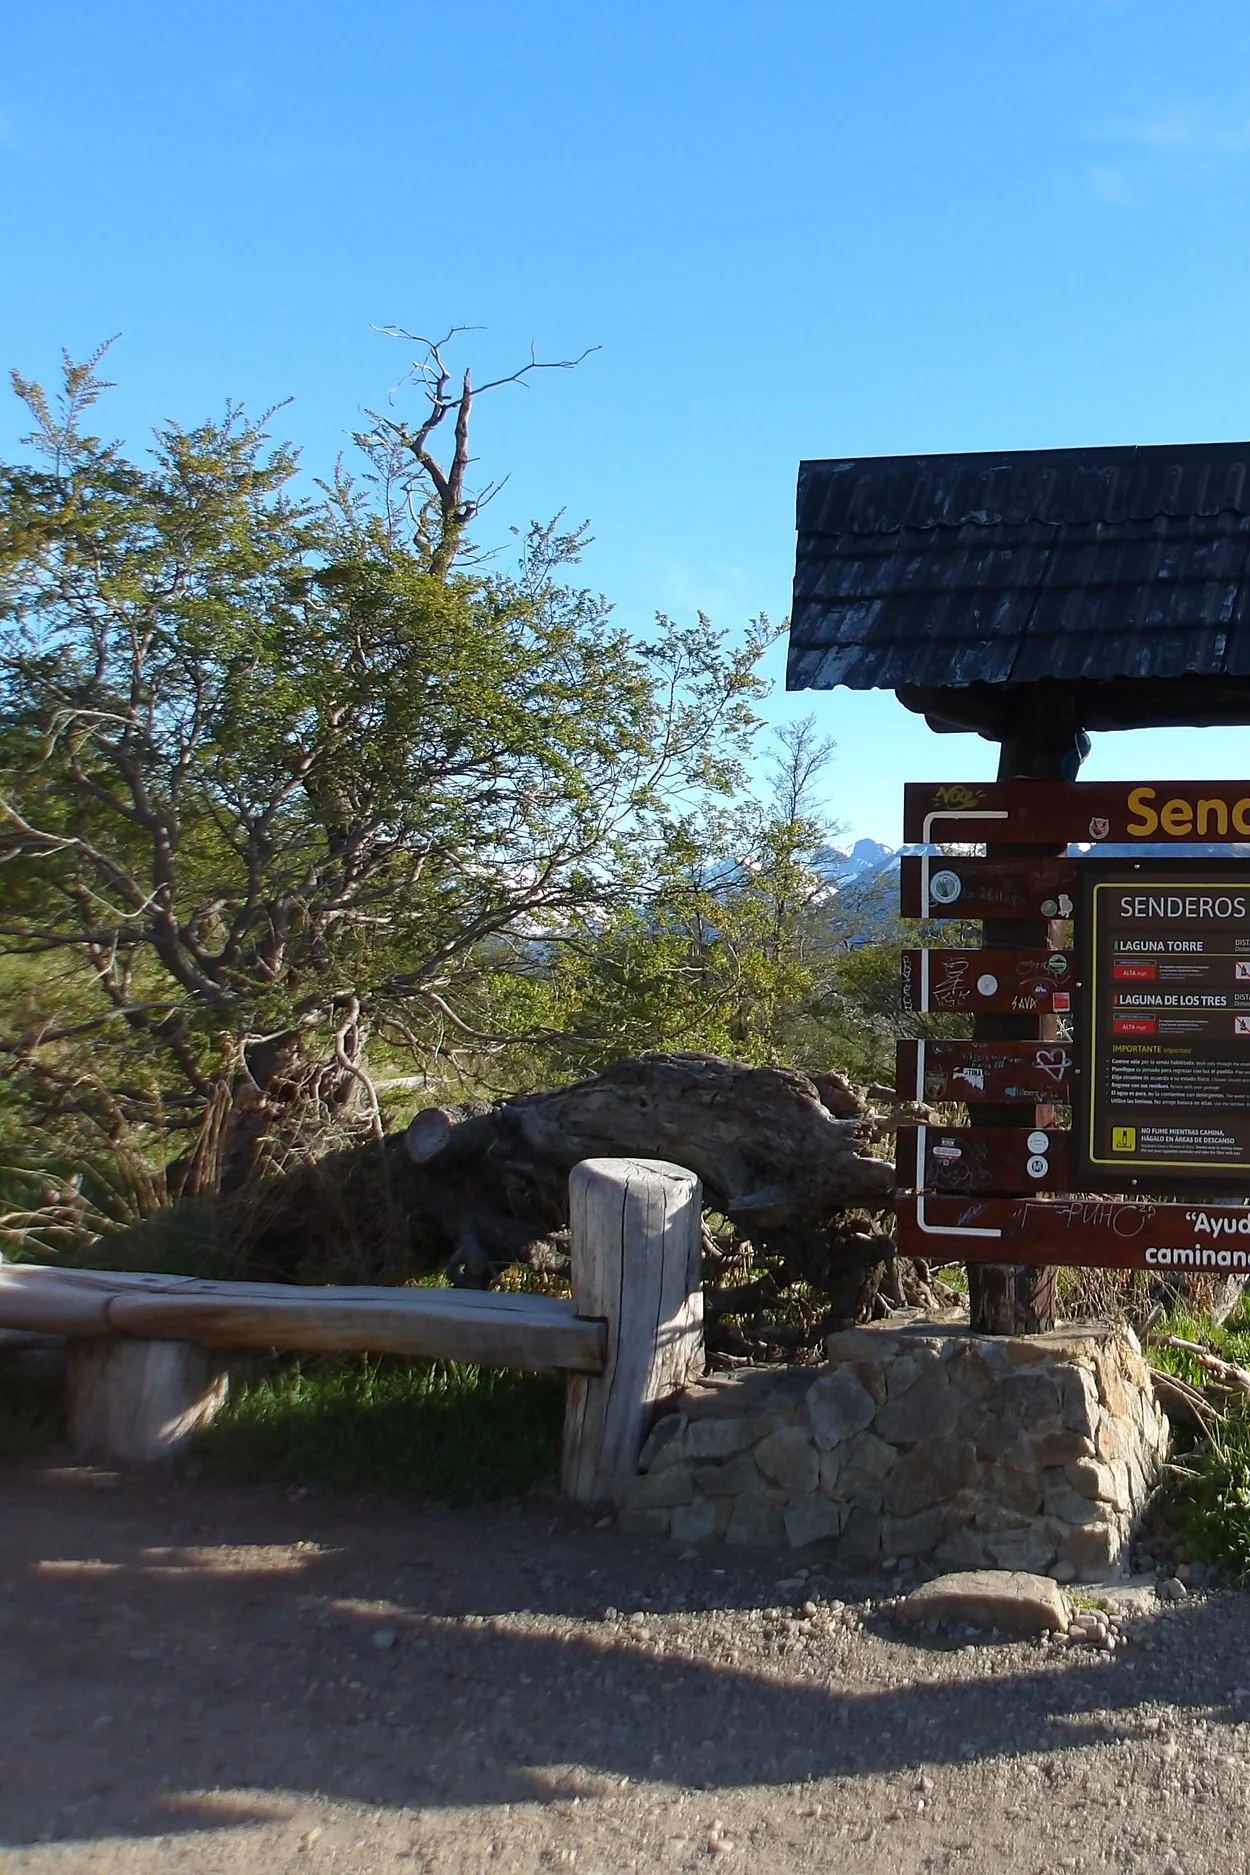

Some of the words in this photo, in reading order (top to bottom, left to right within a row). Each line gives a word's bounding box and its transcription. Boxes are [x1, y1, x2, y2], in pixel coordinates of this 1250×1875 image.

[1120, 896, 1246, 918] SENDEROS
[1120, 940, 1164, 951] LAGUNA
[1167, 941, 1204, 952] TORRE
[1119, 994, 1163, 1005] LAGUNA
[1164, 995, 1178, 1005] DE
[1180, 995, 1200, 1005] LOS
[1201, 996, 1227, 1006] TRES
[1112, 1045, 1162, 1053] IMPORTANTE
